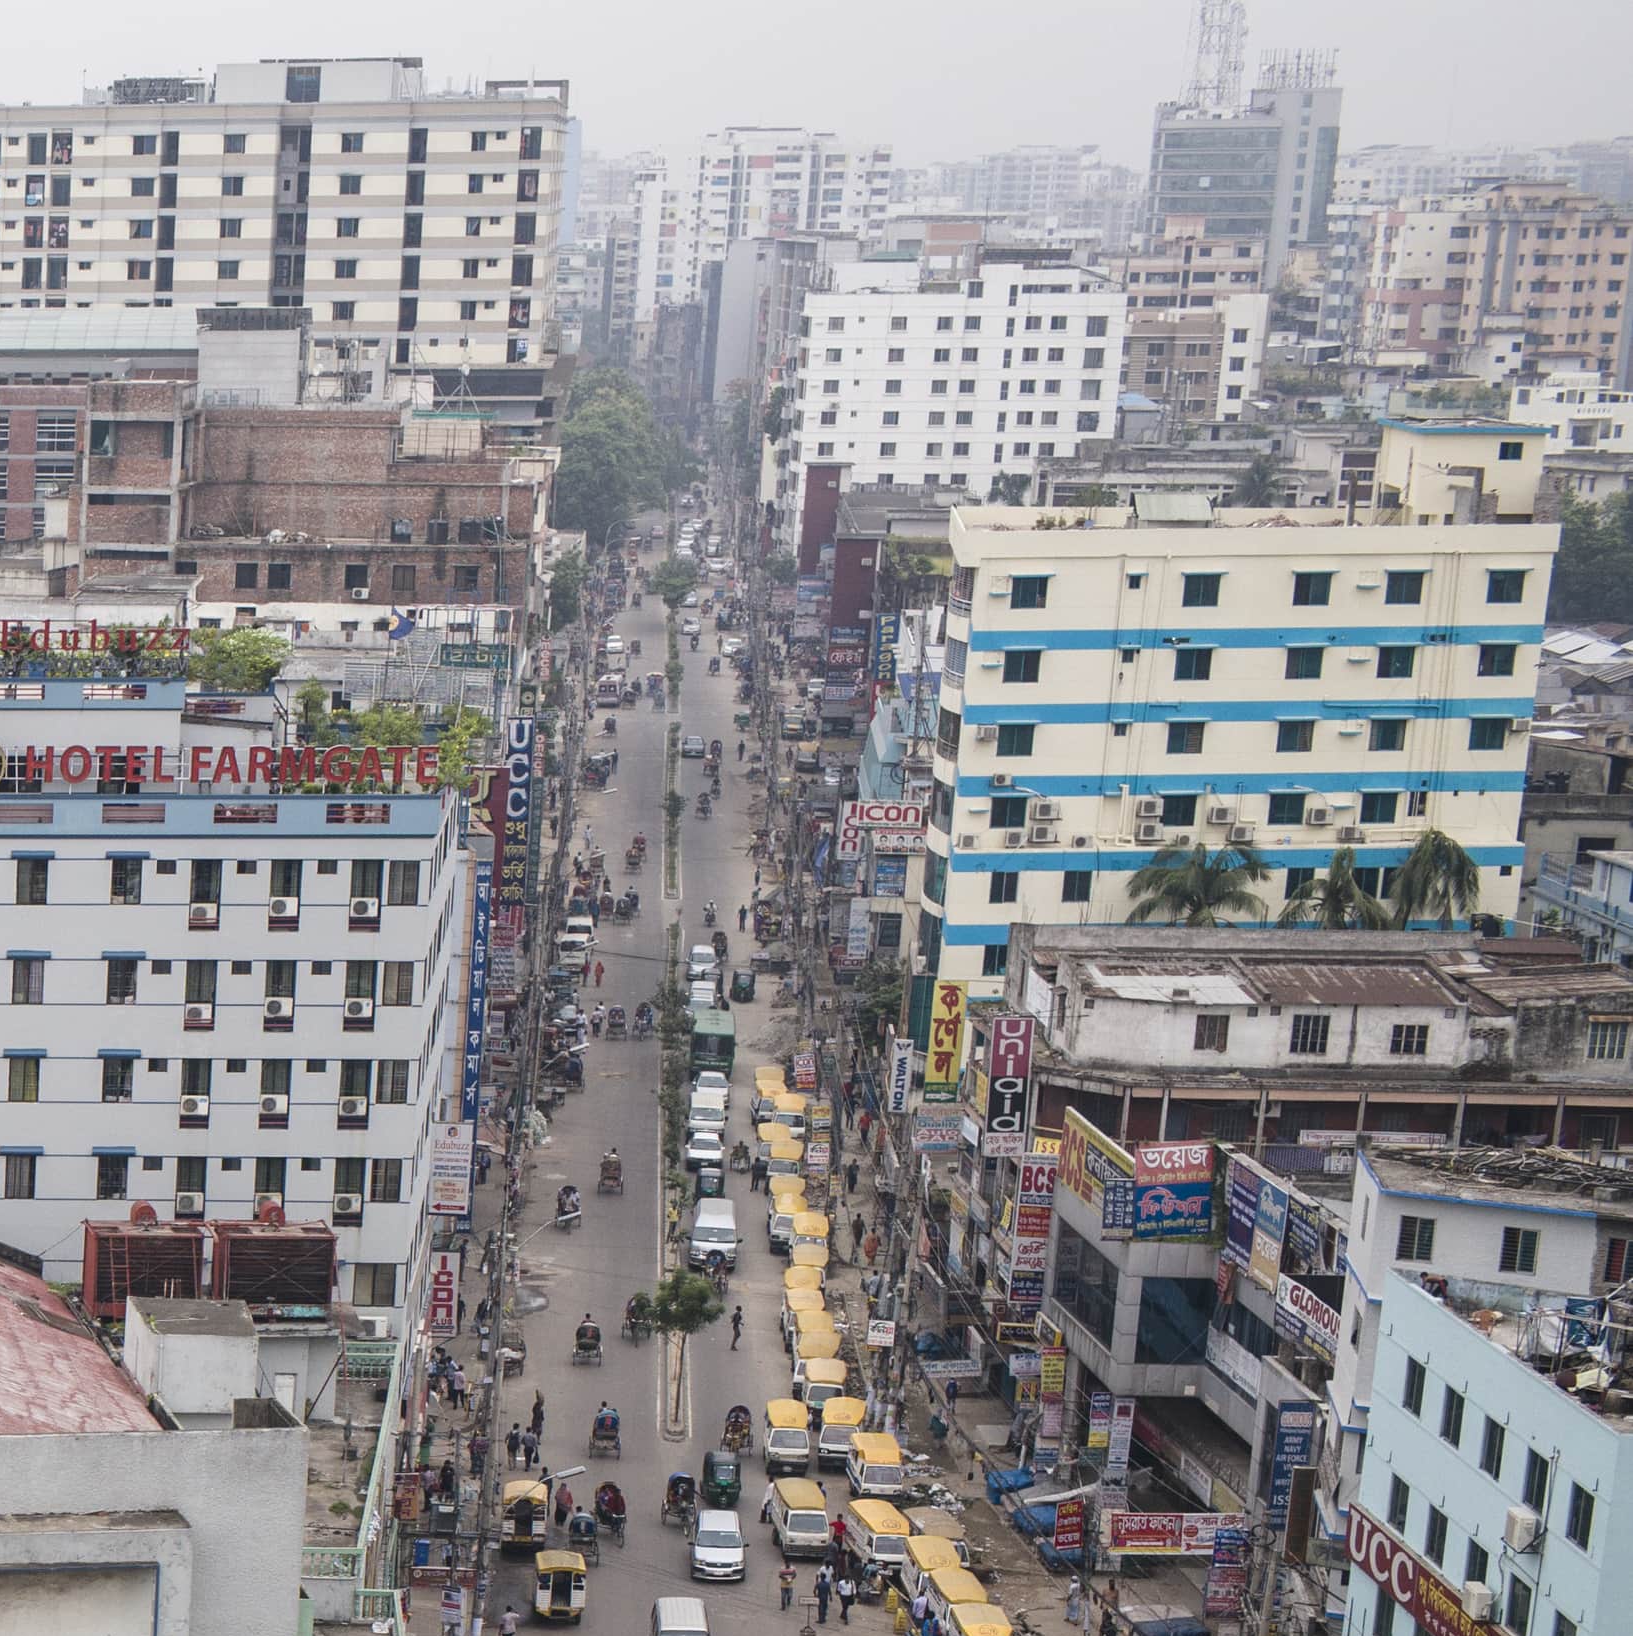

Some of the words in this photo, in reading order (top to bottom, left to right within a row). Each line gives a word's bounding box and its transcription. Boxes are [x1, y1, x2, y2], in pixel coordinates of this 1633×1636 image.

[0, 618, 191, 651] Edubuzz
[878, 616, 897, 679] Paragon
[25, 745, 175, 784] HOTEL
[190, 745, 441, 785] FARMGATE
[505, 719, 533, 819] UCC
[892, 1055, 909, 1111] WALTON
[434, 1139, 470, 1151] Edubuzz
[1141, 1144, 1210, 1169] ভয়েজ
[1020, 1165, 1056, 1194] BCS
[1283, 1436, 1304, 1445] ARMY
[1283, 1445, 1303, 1454] NAVY
[1275, 1454, 1287, 1463] AIR
[1287, 1454, 1309, 1464] FORCE
[1348, 1507, 1414, 1603] UCC
